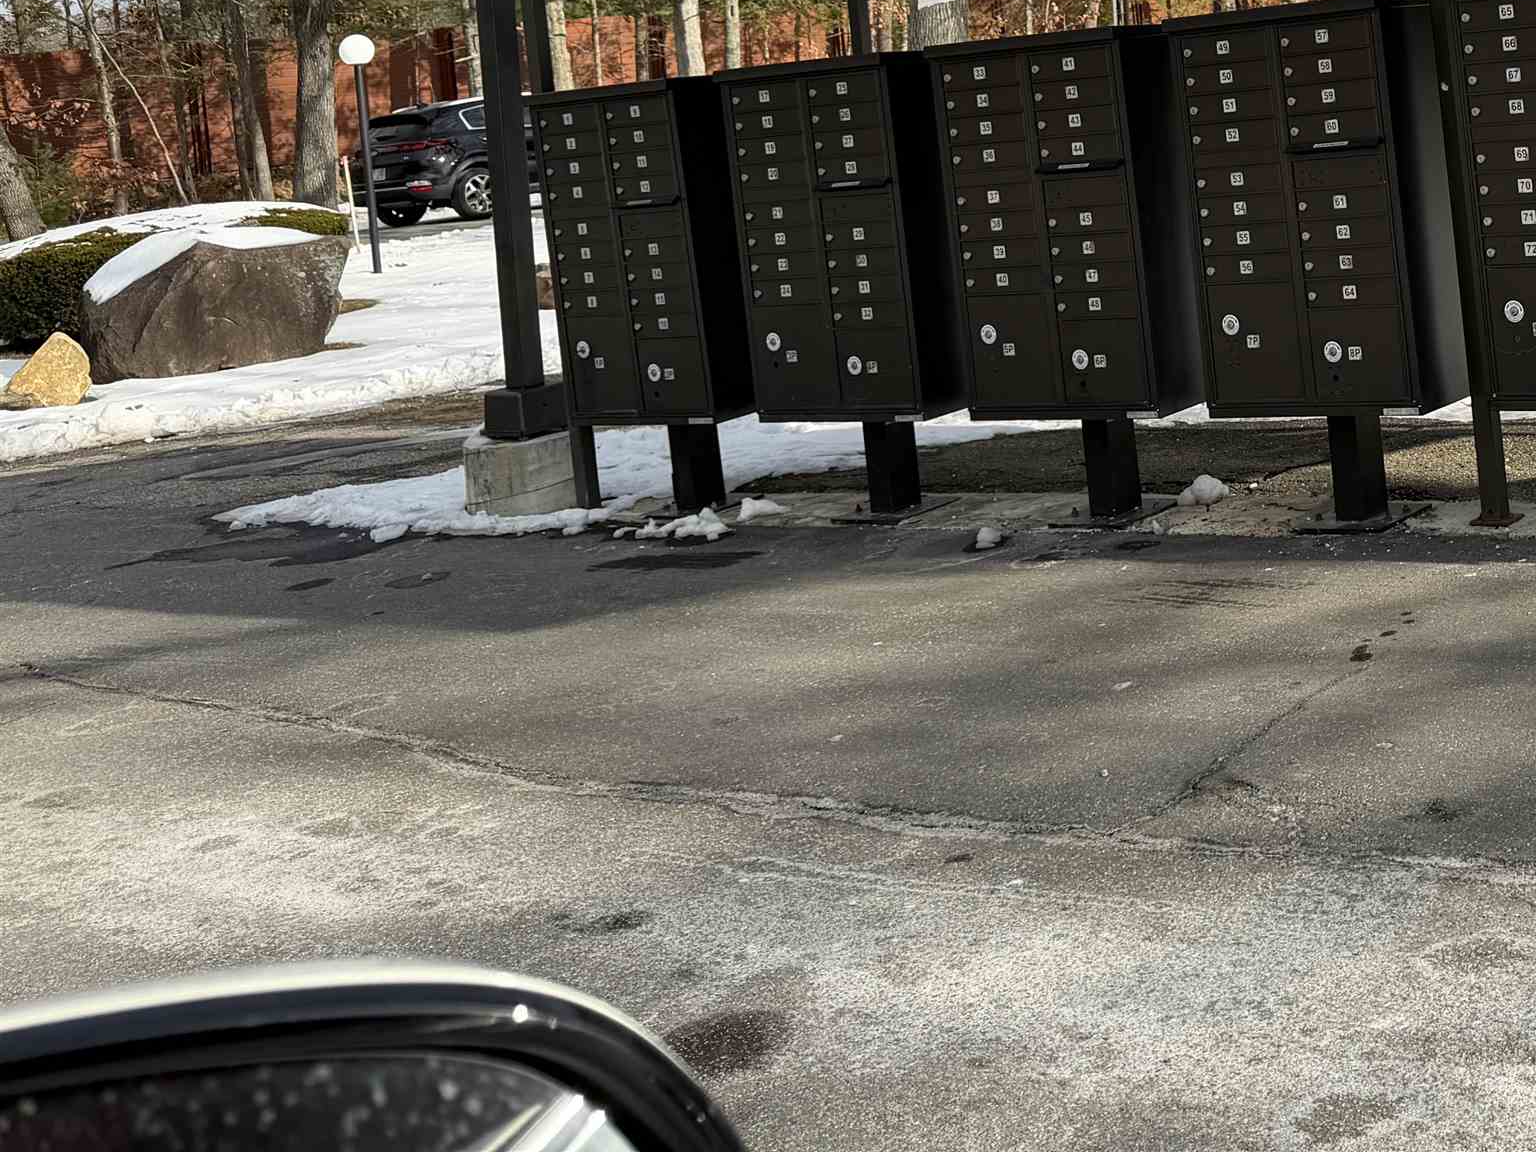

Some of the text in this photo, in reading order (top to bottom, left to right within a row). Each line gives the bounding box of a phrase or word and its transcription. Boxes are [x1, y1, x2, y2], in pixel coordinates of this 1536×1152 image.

[1500, 6, 1512, 18] 65
[1316, 30, 1327, 42] 57
[1217, 41, 1228, 52] 49
[1504, 38, 1516, 50] 66
[1320, 60, 1330, 72] 58
[975, 68, 984, 78] 33
[1221, 71, 1231, 82] 50
[1508, 70, 1520, 80] 67
[1323, 89, 1334, 102] 59
[1224, 100, 1235, 110] 51
[1510, 100, 1522, 112] 68
[1227, 129, 1238, 140] 52
[1516, 148, 1528, 160] 69
[1232, 173, 1243, 184] 53
[1520, 180, 1532, 192] 70
[1081, 213, 1091, 224] 45
[1522, 212, 1534, 222] 71
[1238, 232, 1249, 242] 55
[1338, 226, 1348, 238] 62
[776, 234, 784, 244] 22
[1241, 262, 1252, 272] 56
